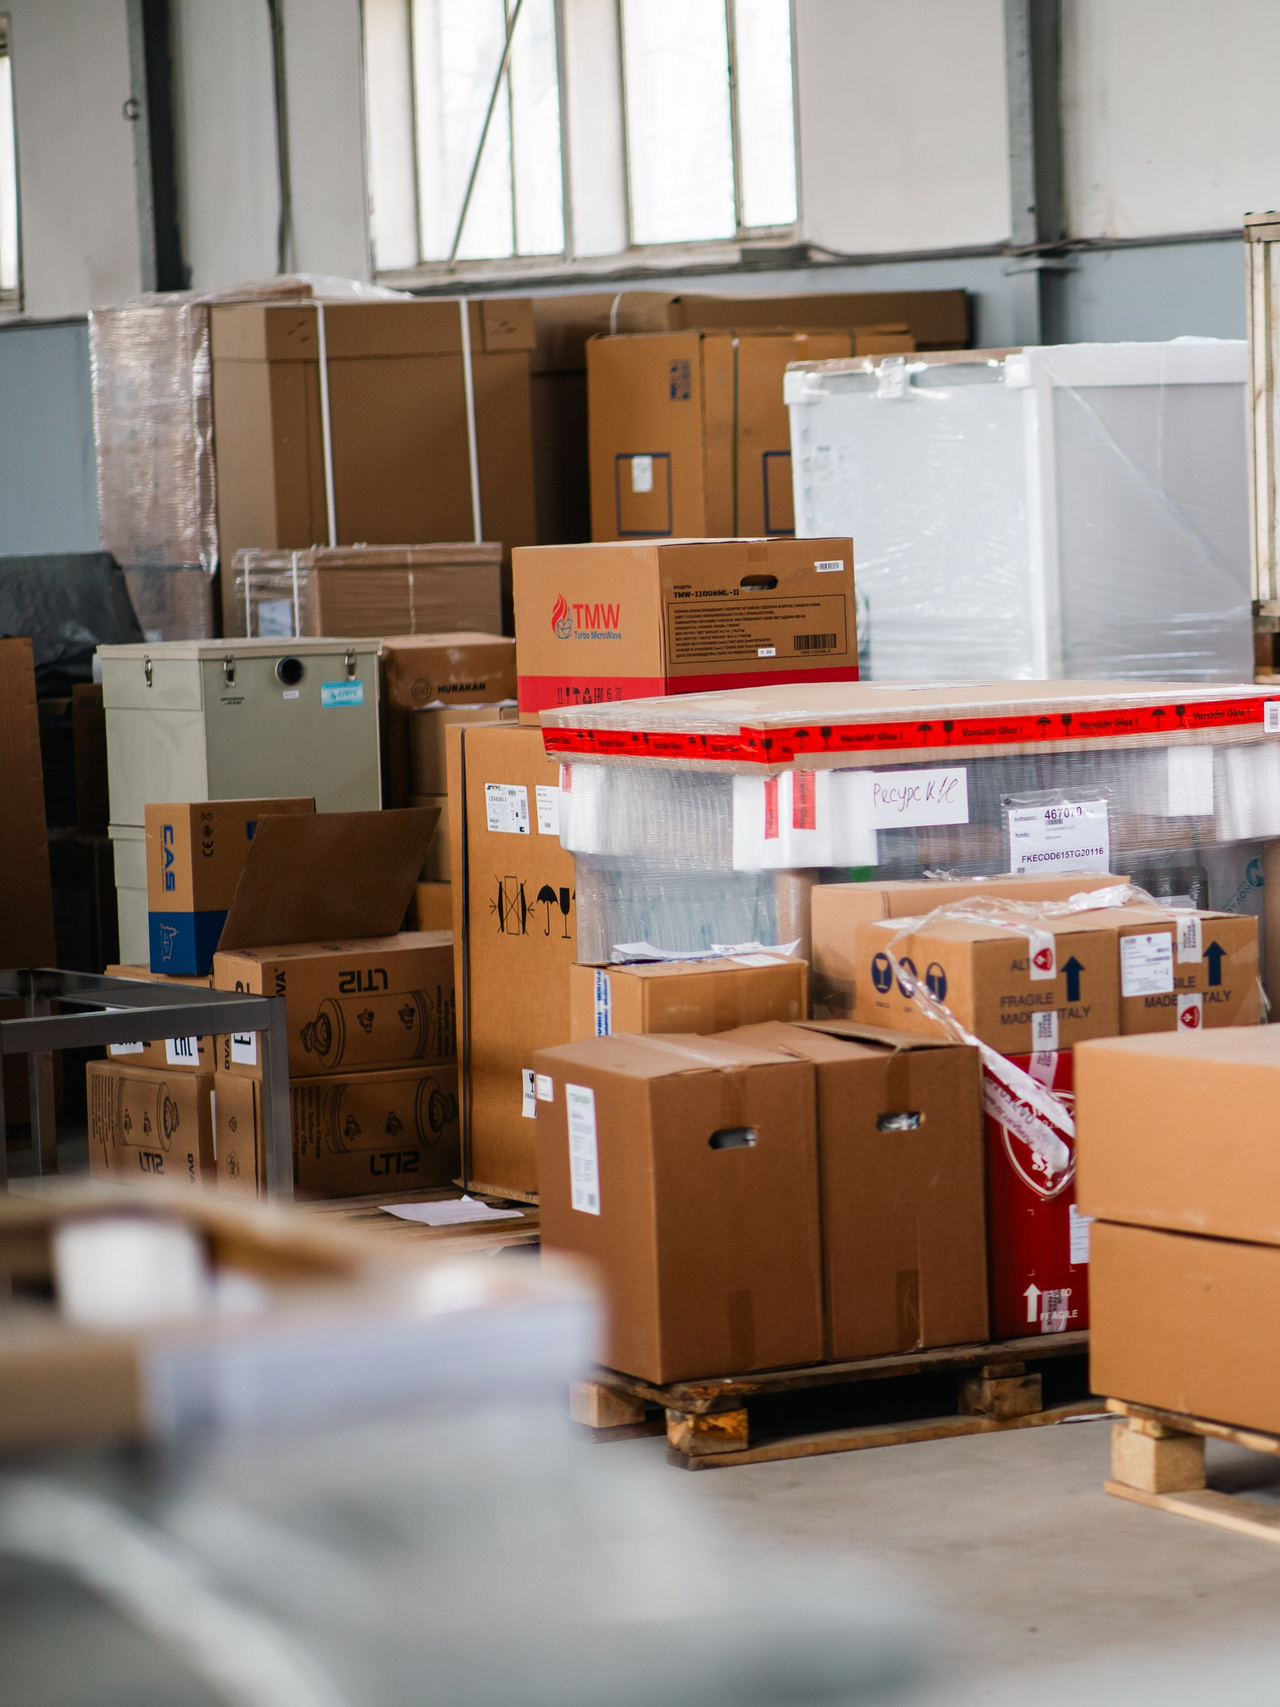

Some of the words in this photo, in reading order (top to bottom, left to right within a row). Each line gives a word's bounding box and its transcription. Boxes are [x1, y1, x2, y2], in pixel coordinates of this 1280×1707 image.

[572, 604, 620, 629] TMW
[574, 631, 590, 639] Turbo
[591, 631, 622, 639] MicroWave
[437, 682, 486, 694] HURAKAN
[1192, 709, 1225, 720] Vorsicht
[1227, 708, 1246, 718] Glas
[1079, 718, 1113, 730] Vorsicht
[1114, 717, 1134, 728] Glas
[839, 733, 875, 744] Vorsicht
[877, 731, 898, 742] Glas
[961, 727, 996, 737] Vorsicht
[998, 725, 1018, 735] Glas
[873, 782, 922, 812] Ресурс
[163, 824, 176, 891] CAS
[1021, 847, 1104, 863] FKECOD615TG20116
[1011, 958, 1030, 971] ALT
[1000, 992, 1053, 1008] FRAGILE
[1145, 995, 1178, 1008] MADE
[1202, 991, 1231, 1004] TALY
